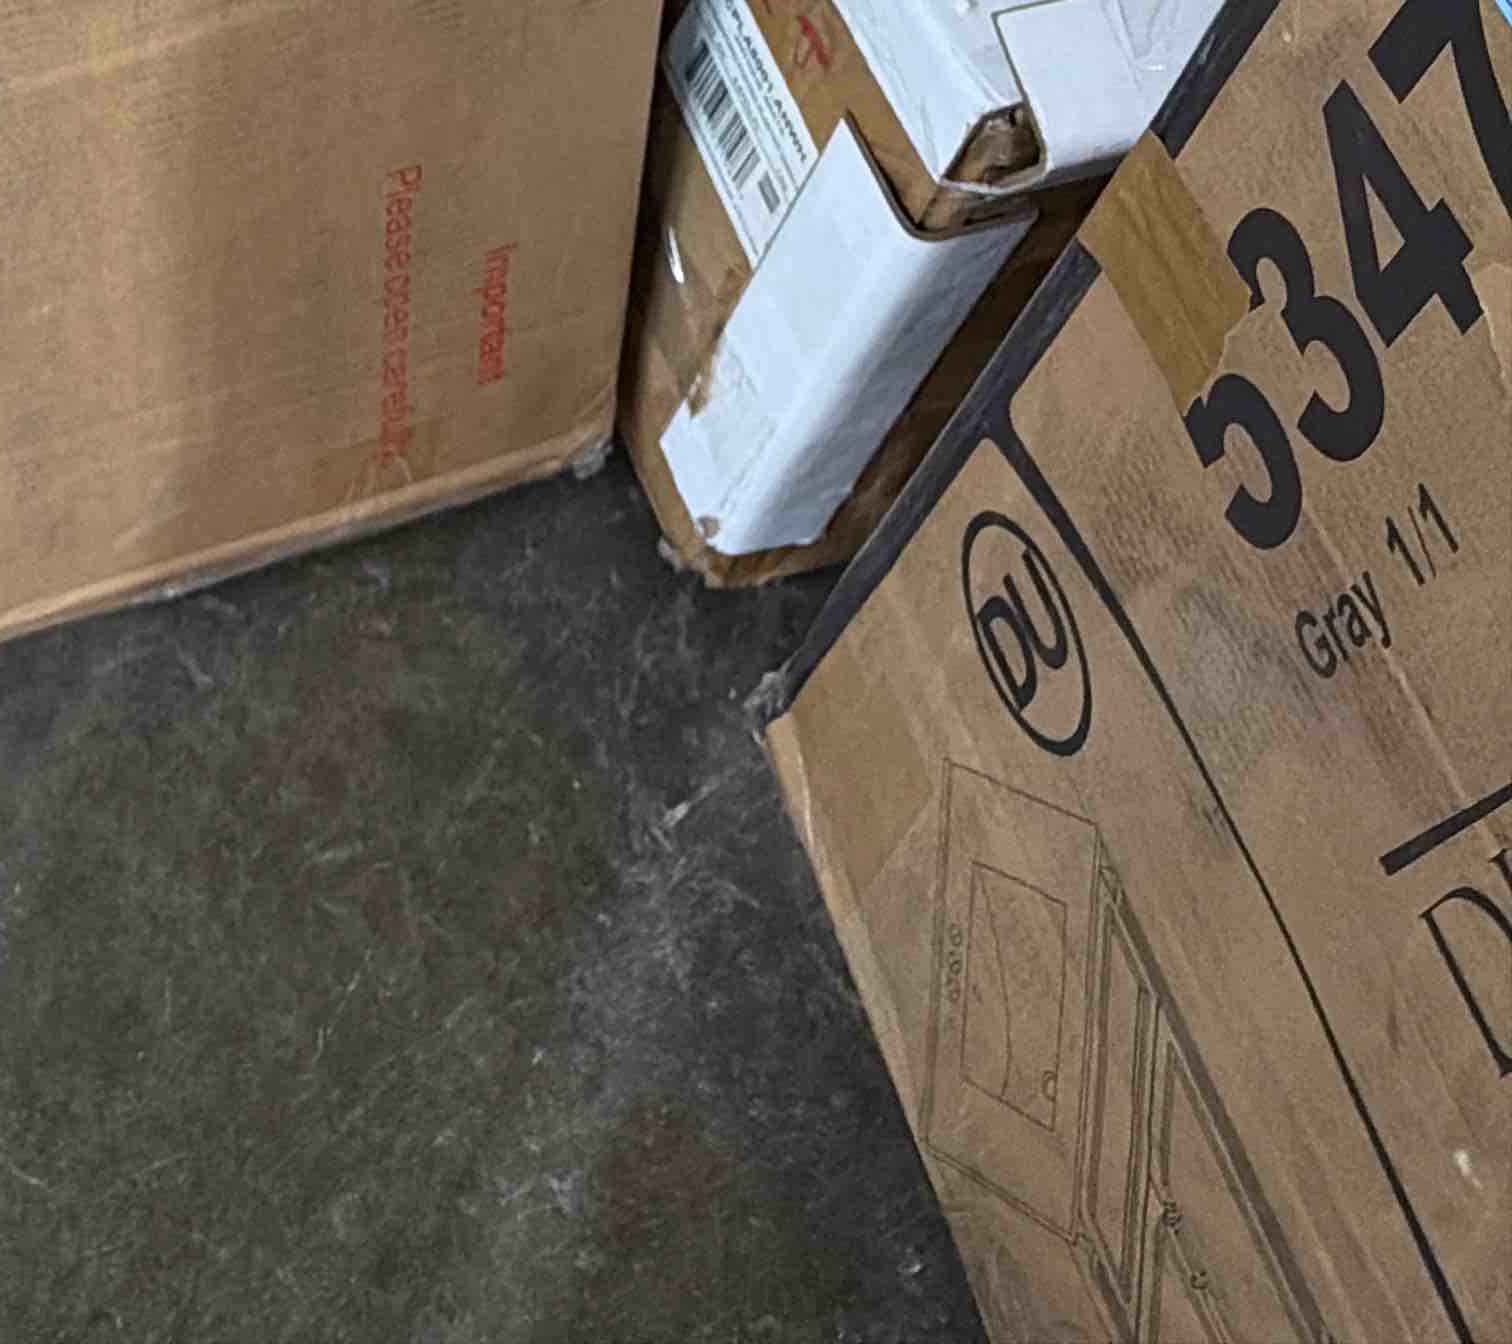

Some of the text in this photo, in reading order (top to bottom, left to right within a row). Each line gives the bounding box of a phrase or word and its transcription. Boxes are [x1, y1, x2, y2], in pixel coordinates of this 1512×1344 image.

[385, 164, 423, 271] Please
[374, 274, 410, 344] open
[472, 240, 518, 387] Important
[1295, 482, 1459, 679] Gray 1/1
